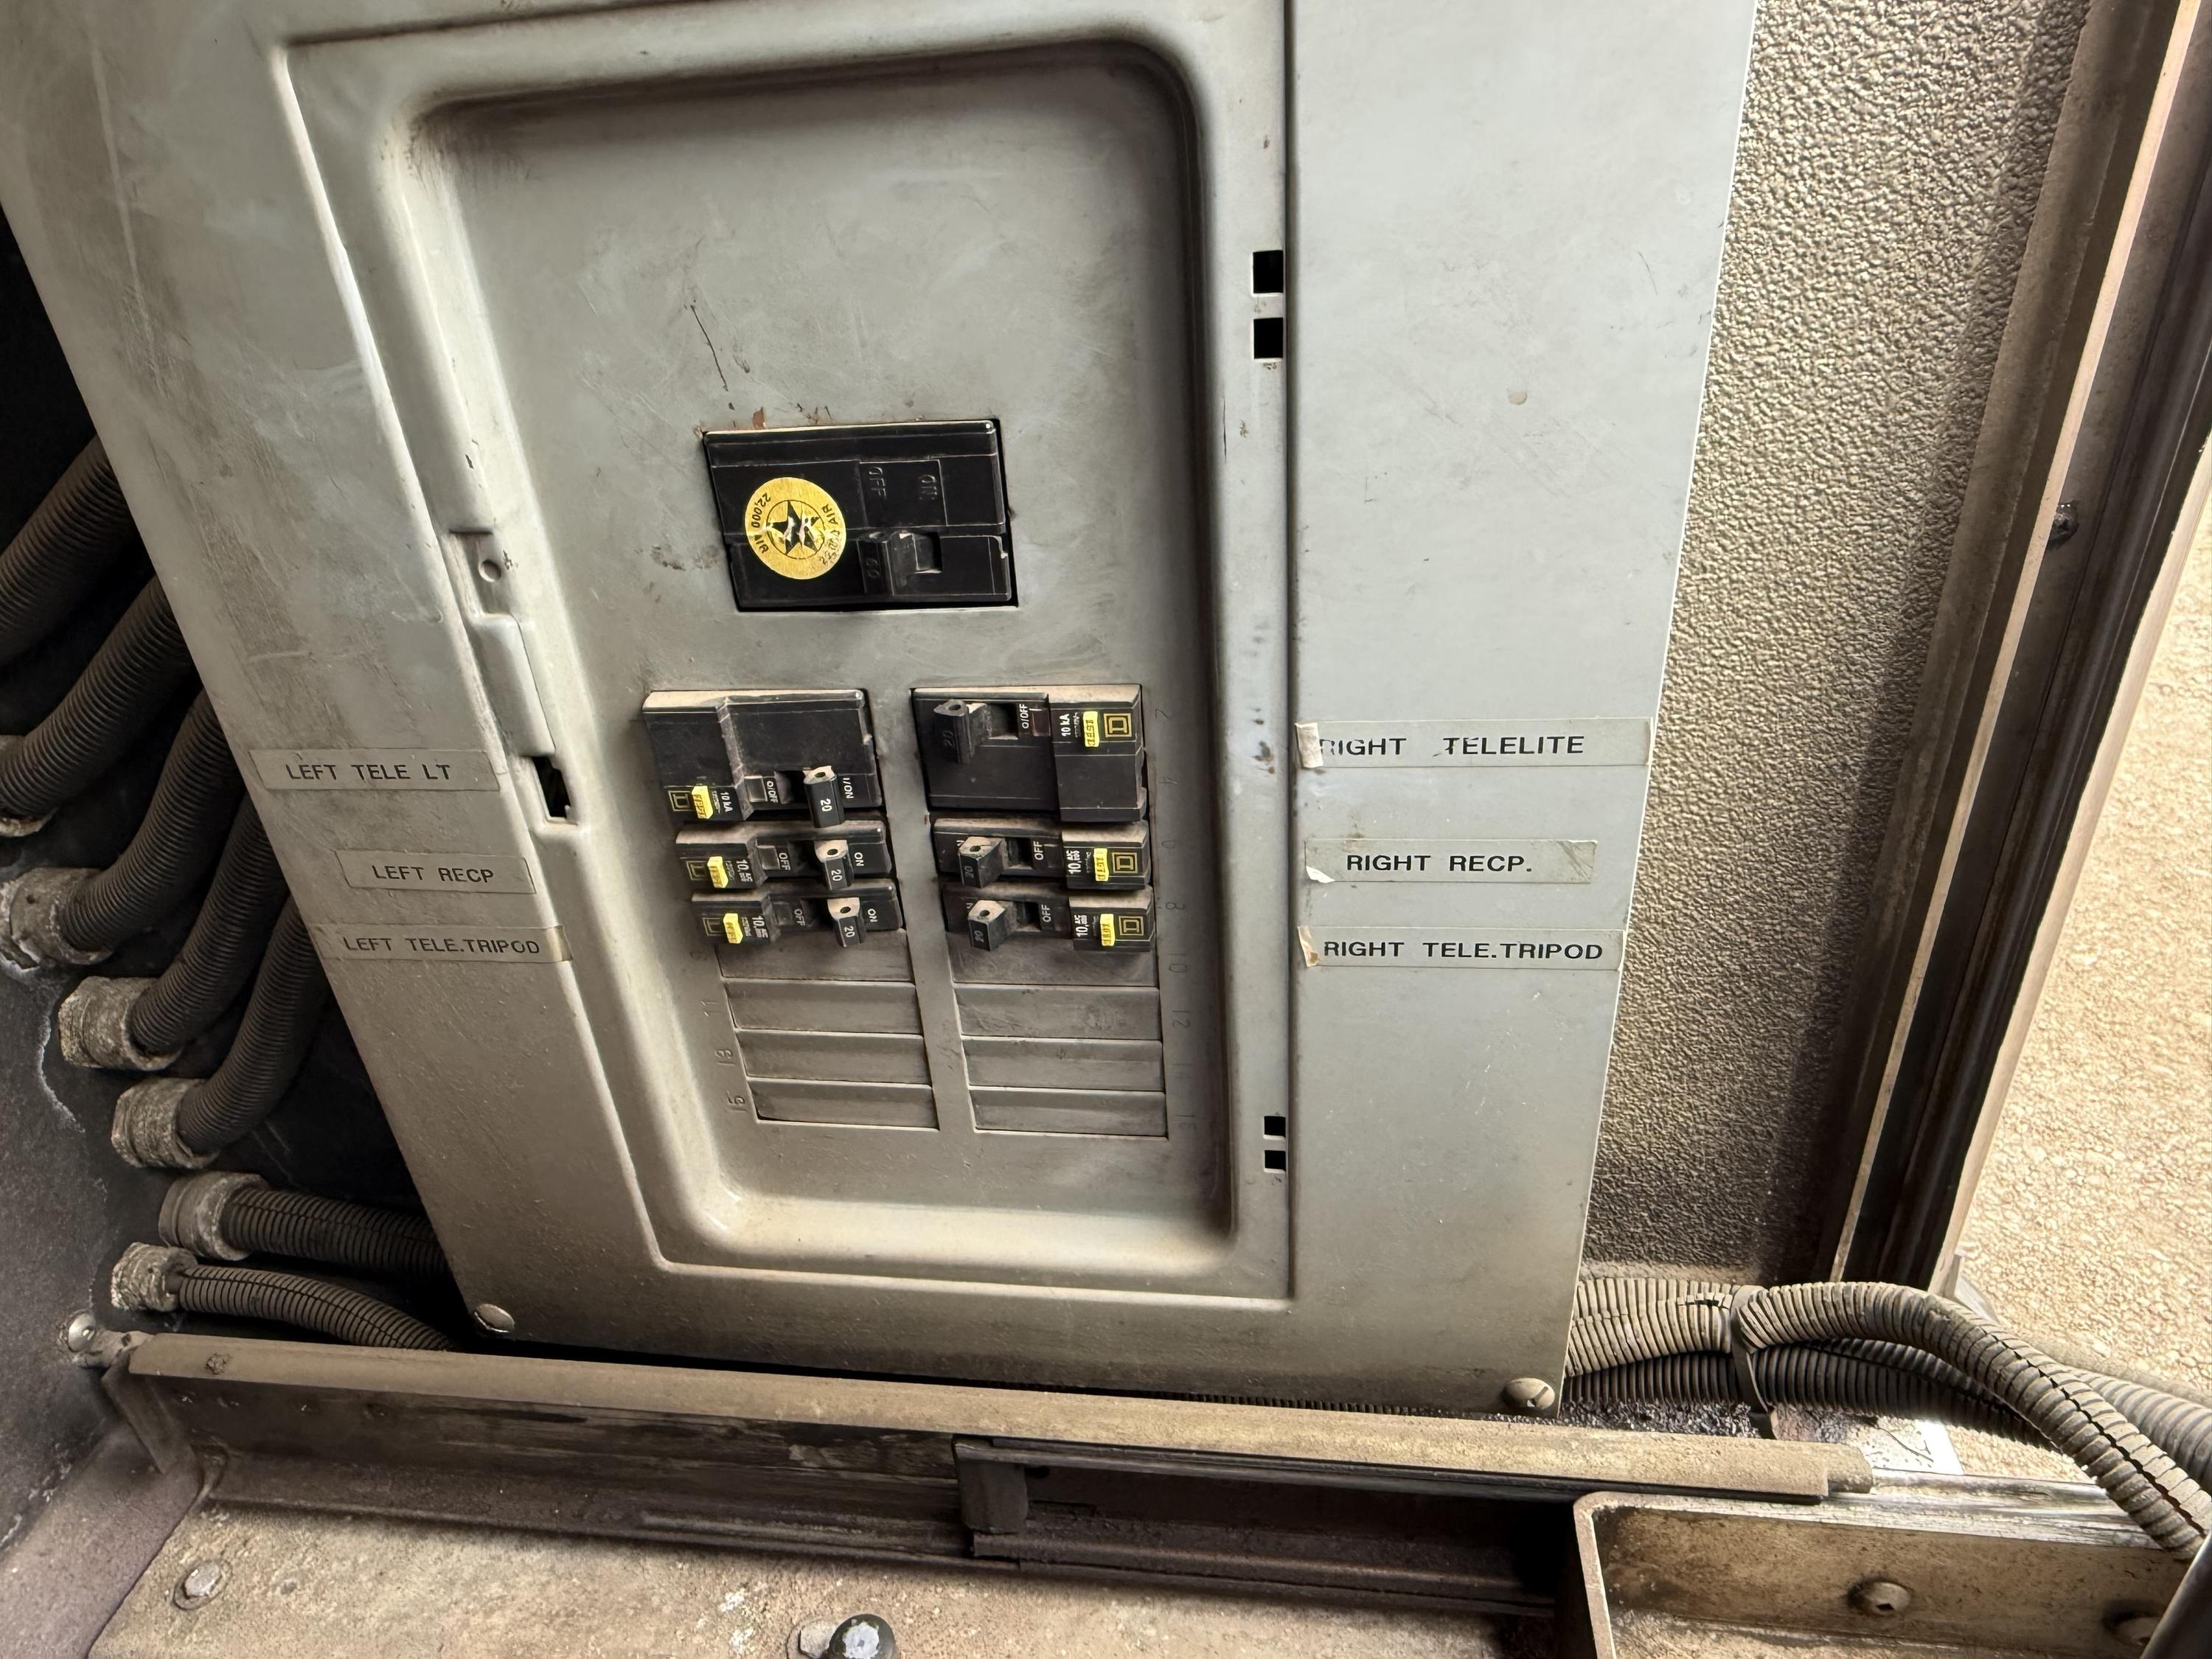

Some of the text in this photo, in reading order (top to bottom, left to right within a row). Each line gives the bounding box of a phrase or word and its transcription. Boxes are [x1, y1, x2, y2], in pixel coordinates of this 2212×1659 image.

[868, 467, 886, 496] OFF
[751, 493, 771, 553] 22,000 AIR
[821, 504, 839, 526] AIR
[1060, 713, 1071, 737] 10 kA
[1442, 736, 1585, 756] TELELITE
[285, 763, 451, 781] LEFT TELE LT
[720, 791, 730, 802] 10
[820, 799, 833, 812] 20
[854, 852, 864, 867] ON
[1033, 841, 1044, 860] OFF
[779, 852, 791, 870] OFF
[1346, 855, 1533, 873] RIGHT RECP.
[371, 865, 495, 883] LEFT RECP
[831, 869, 843, 882] 20
[964, 865, 974, 878] 20
[794, 908, 806, 927] OFF
[867, 908, 878, 923] ON
[1042, 904, 1052, 923] OFF
[844, 925, 855, 938] 20
[974, 930, 985, 943] 20
[342, 936, 540, 954] LEFT TELE.TRIPOD
[1324, 941, 1604, 959] RIGHT TELE.TRIPOD
[1172, 1009, 1192, 1029] 12
[726, 1090, 746, 1113] 15
